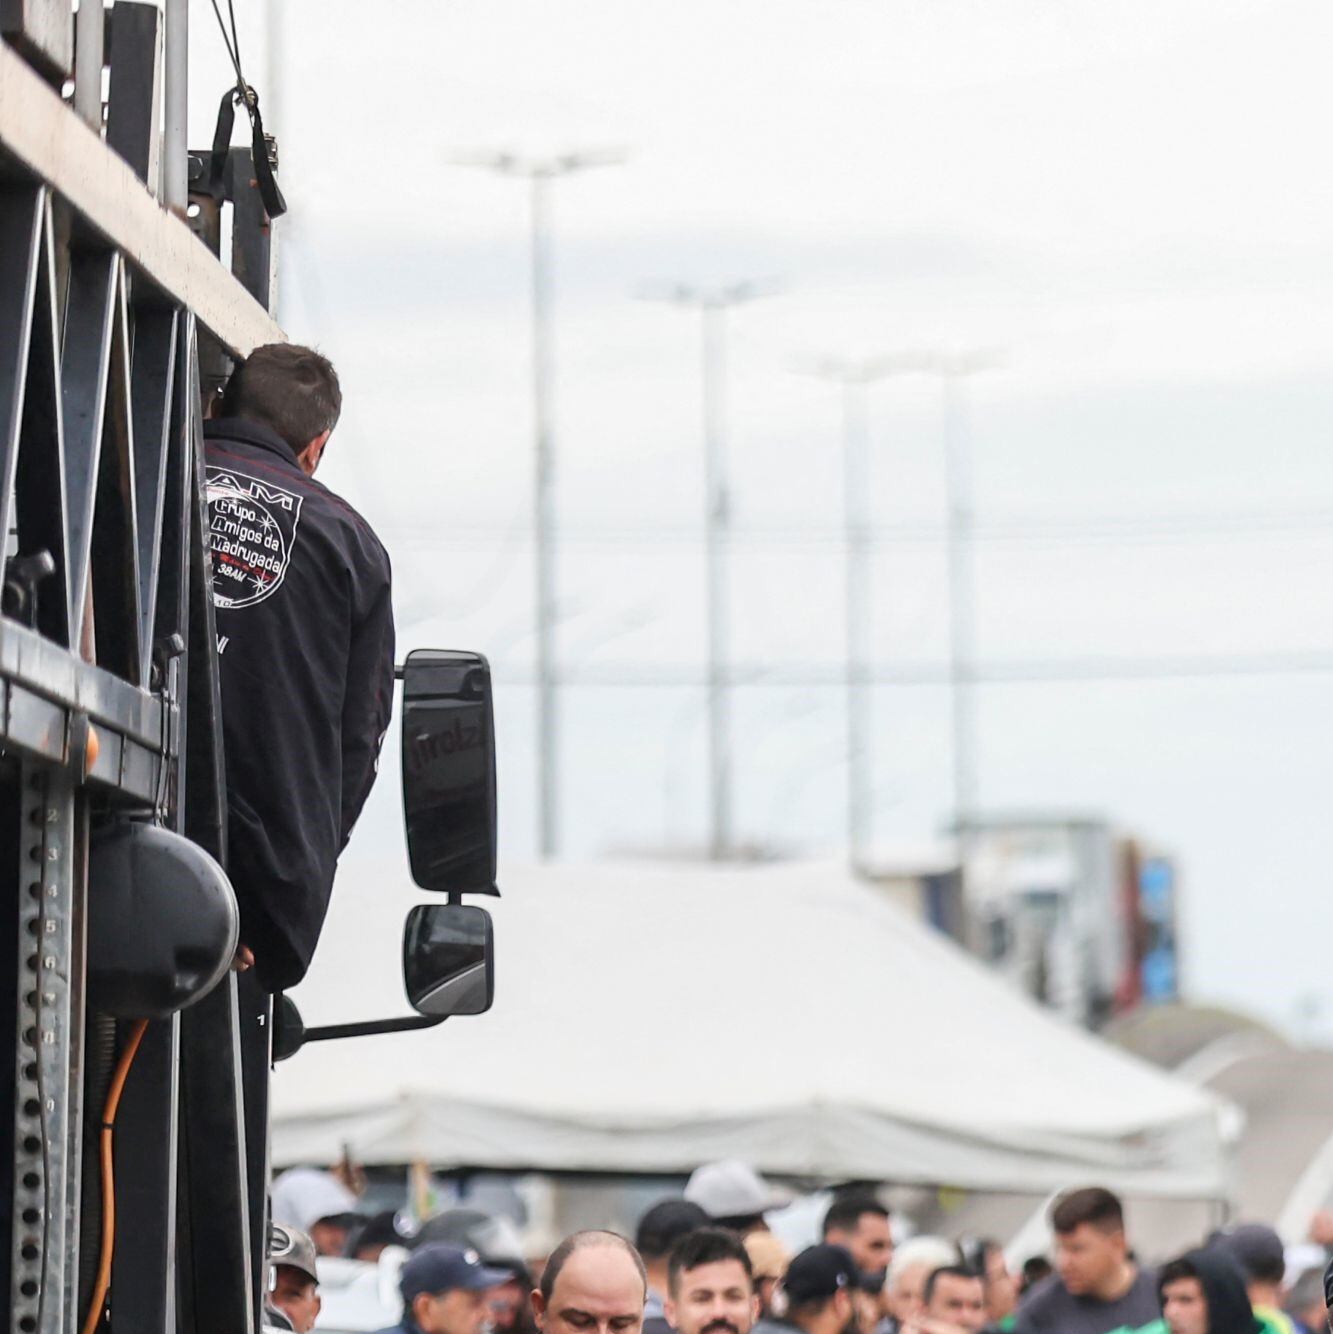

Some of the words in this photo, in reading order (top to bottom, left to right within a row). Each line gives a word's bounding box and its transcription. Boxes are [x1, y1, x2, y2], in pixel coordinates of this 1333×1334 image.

[214, 499, 256, 524] Grupo
[211, 515, 262, 543] Amigos
[264, 533, 280, 551] da
[210, 533, 281, 573] Madrugada
[47, 808, 58, 822] 2
[47, 848, 58, 861] 3
[46, 919, 57, 933] 5
[45, 956, 56, 969] 6
